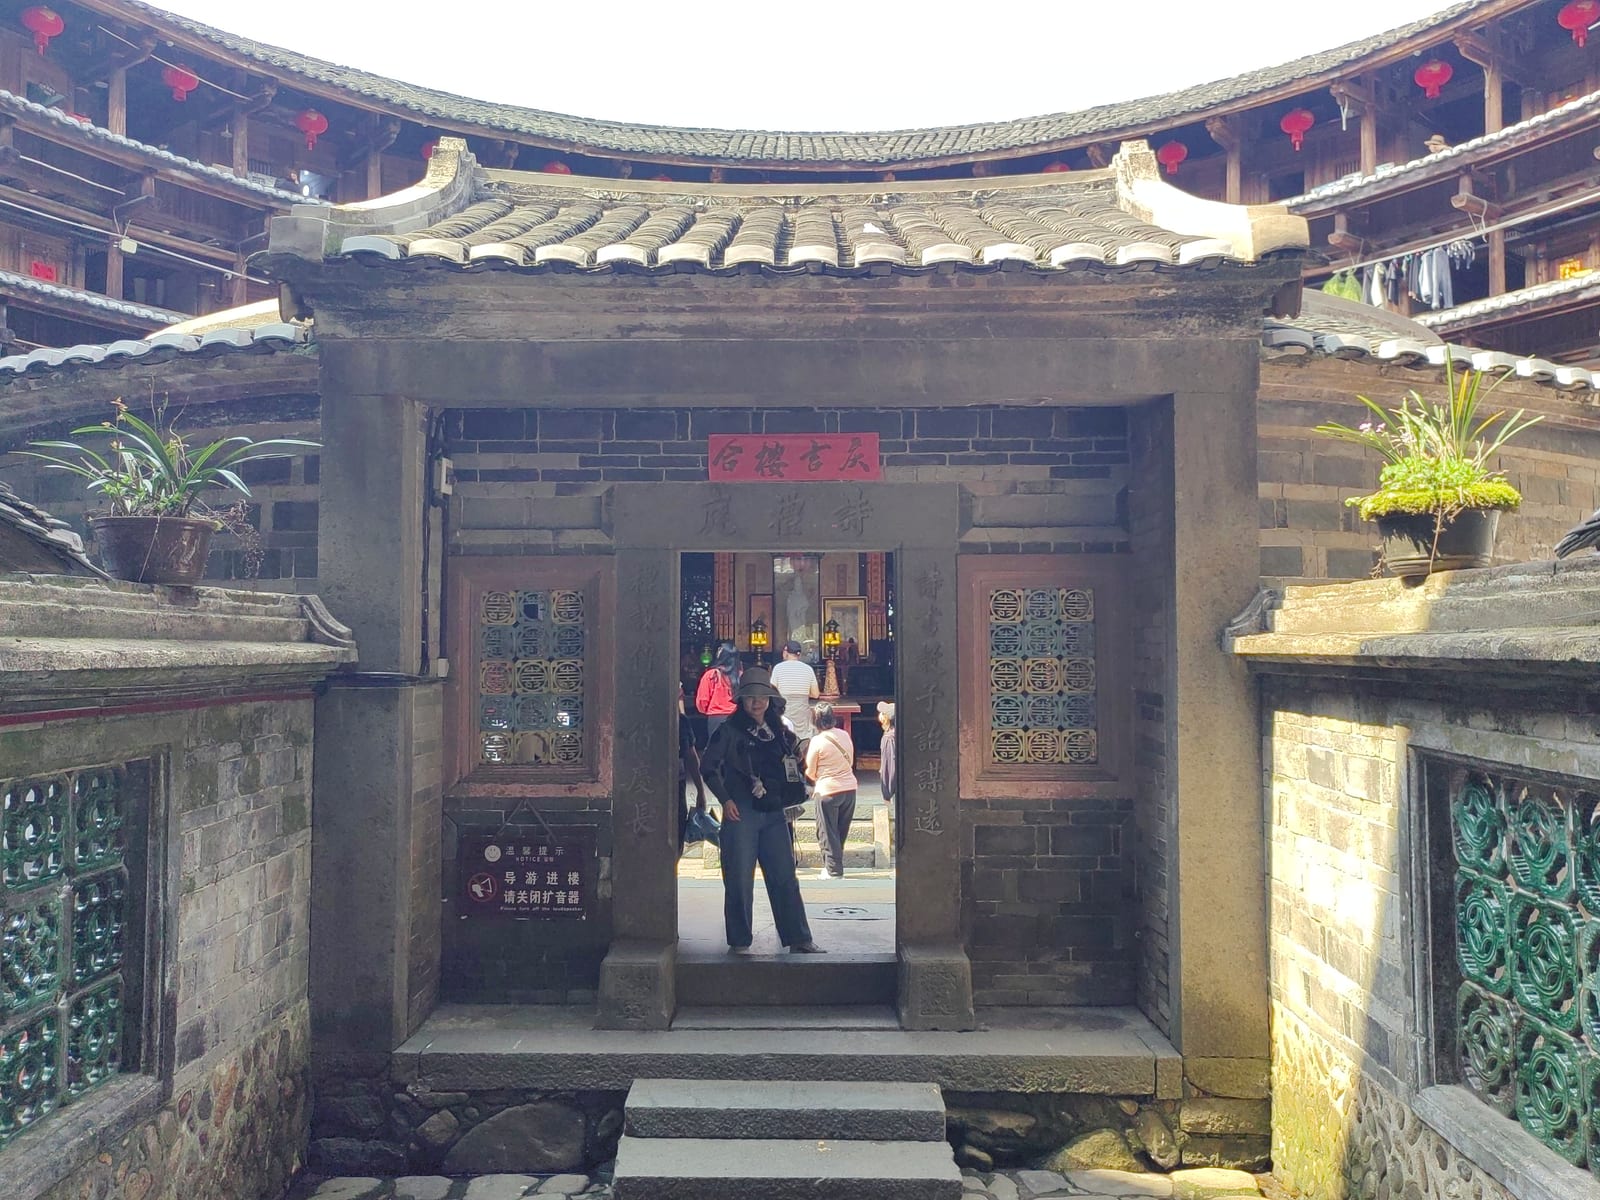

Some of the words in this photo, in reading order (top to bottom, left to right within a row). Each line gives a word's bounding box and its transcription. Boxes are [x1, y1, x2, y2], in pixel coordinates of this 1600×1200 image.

[506, 846, 565, 856] 温馨提示
[504, 872, 580, 885] 导游进楼
[504, 890, 580, 905] 请关闭扩音器
